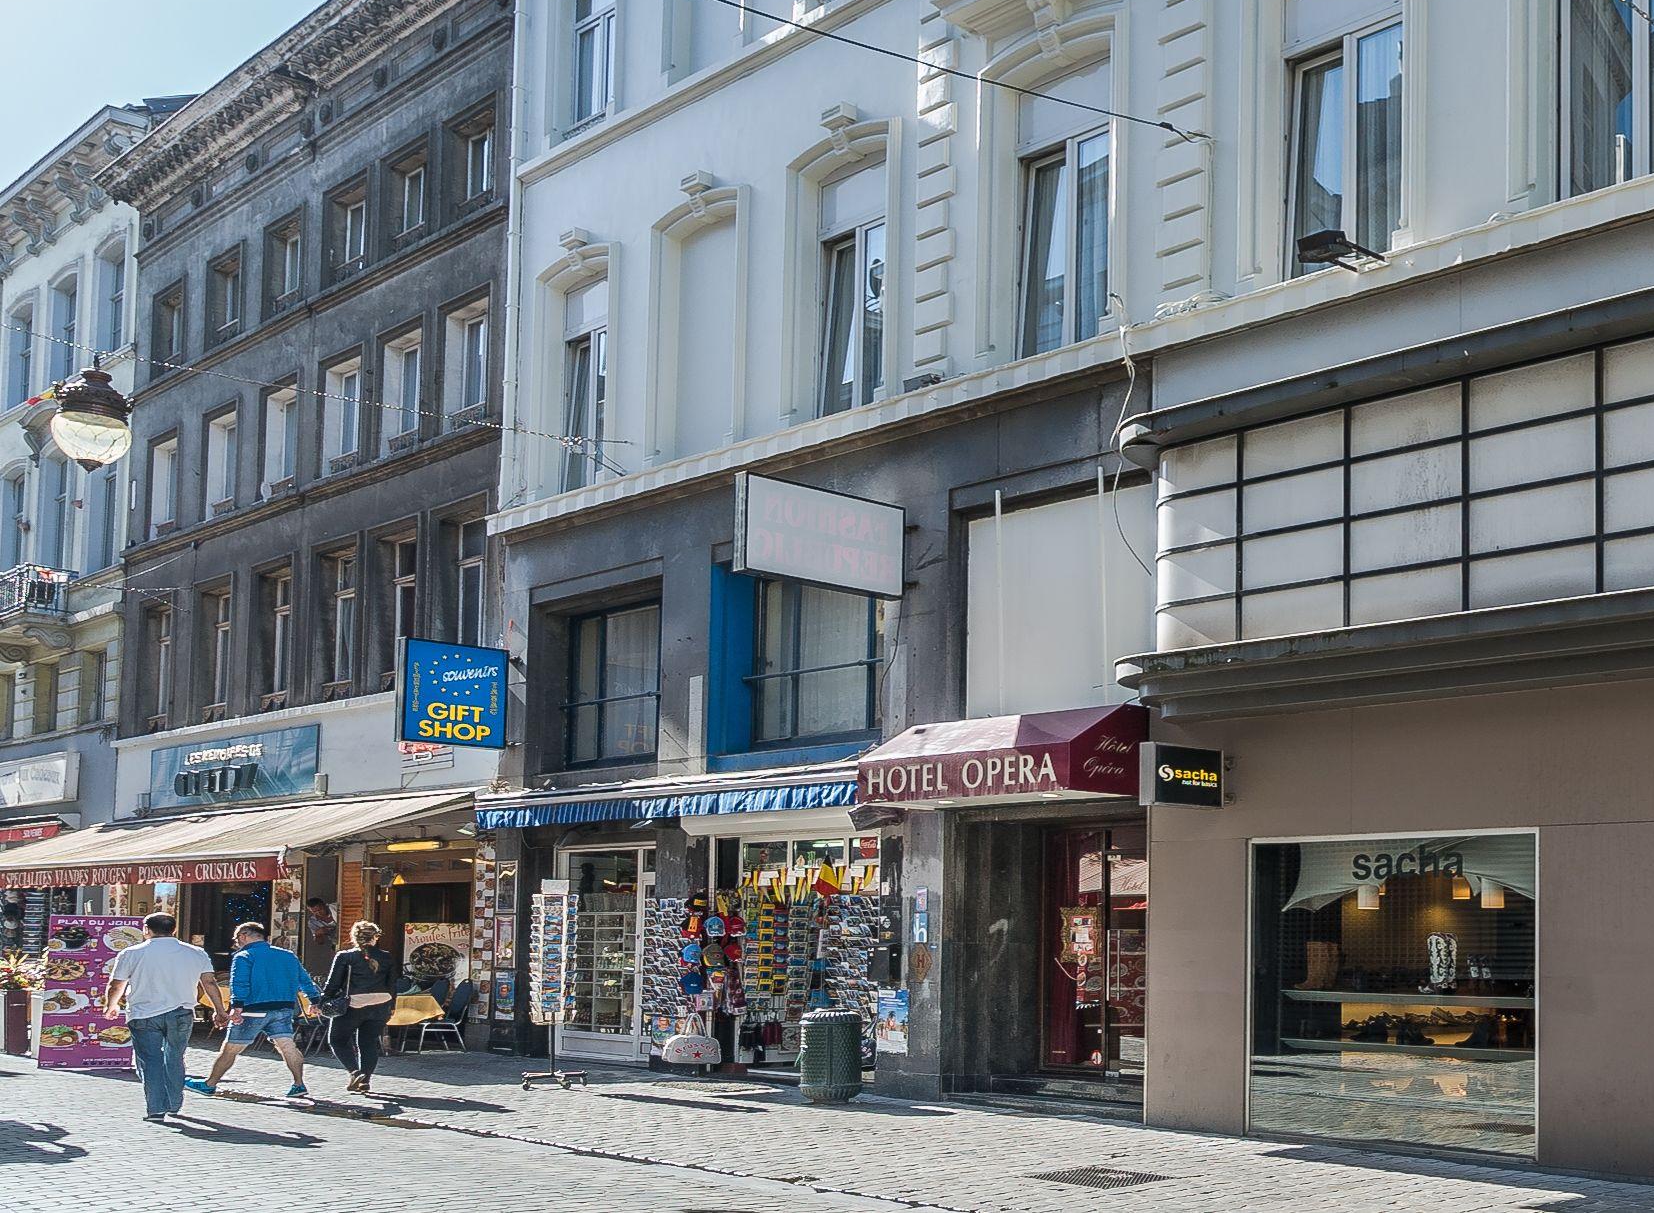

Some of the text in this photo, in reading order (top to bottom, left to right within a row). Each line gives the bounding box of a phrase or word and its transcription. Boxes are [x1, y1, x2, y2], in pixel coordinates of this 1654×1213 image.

[442, 665, 499, 682] souvenirs
[427, 702, 485, 722] GIFT
[418, 719, 491, 741] SHOP
[1094, 734, 1137, 755] Hôtel
[866, 753, 1057, 796] HOTEL OPERA
[1083, 757, 1127, 776] Opéra
[1175, 769, 1217, 781] sacha
[1352, 844, 1463, 881] sacha
[55, 869, 89, 885] VIANDES
[138, 864, 183, 883] POISSONS
[195, 862, 257, 881] CRUSTACES
[408, 932, 446, 946] Moules
